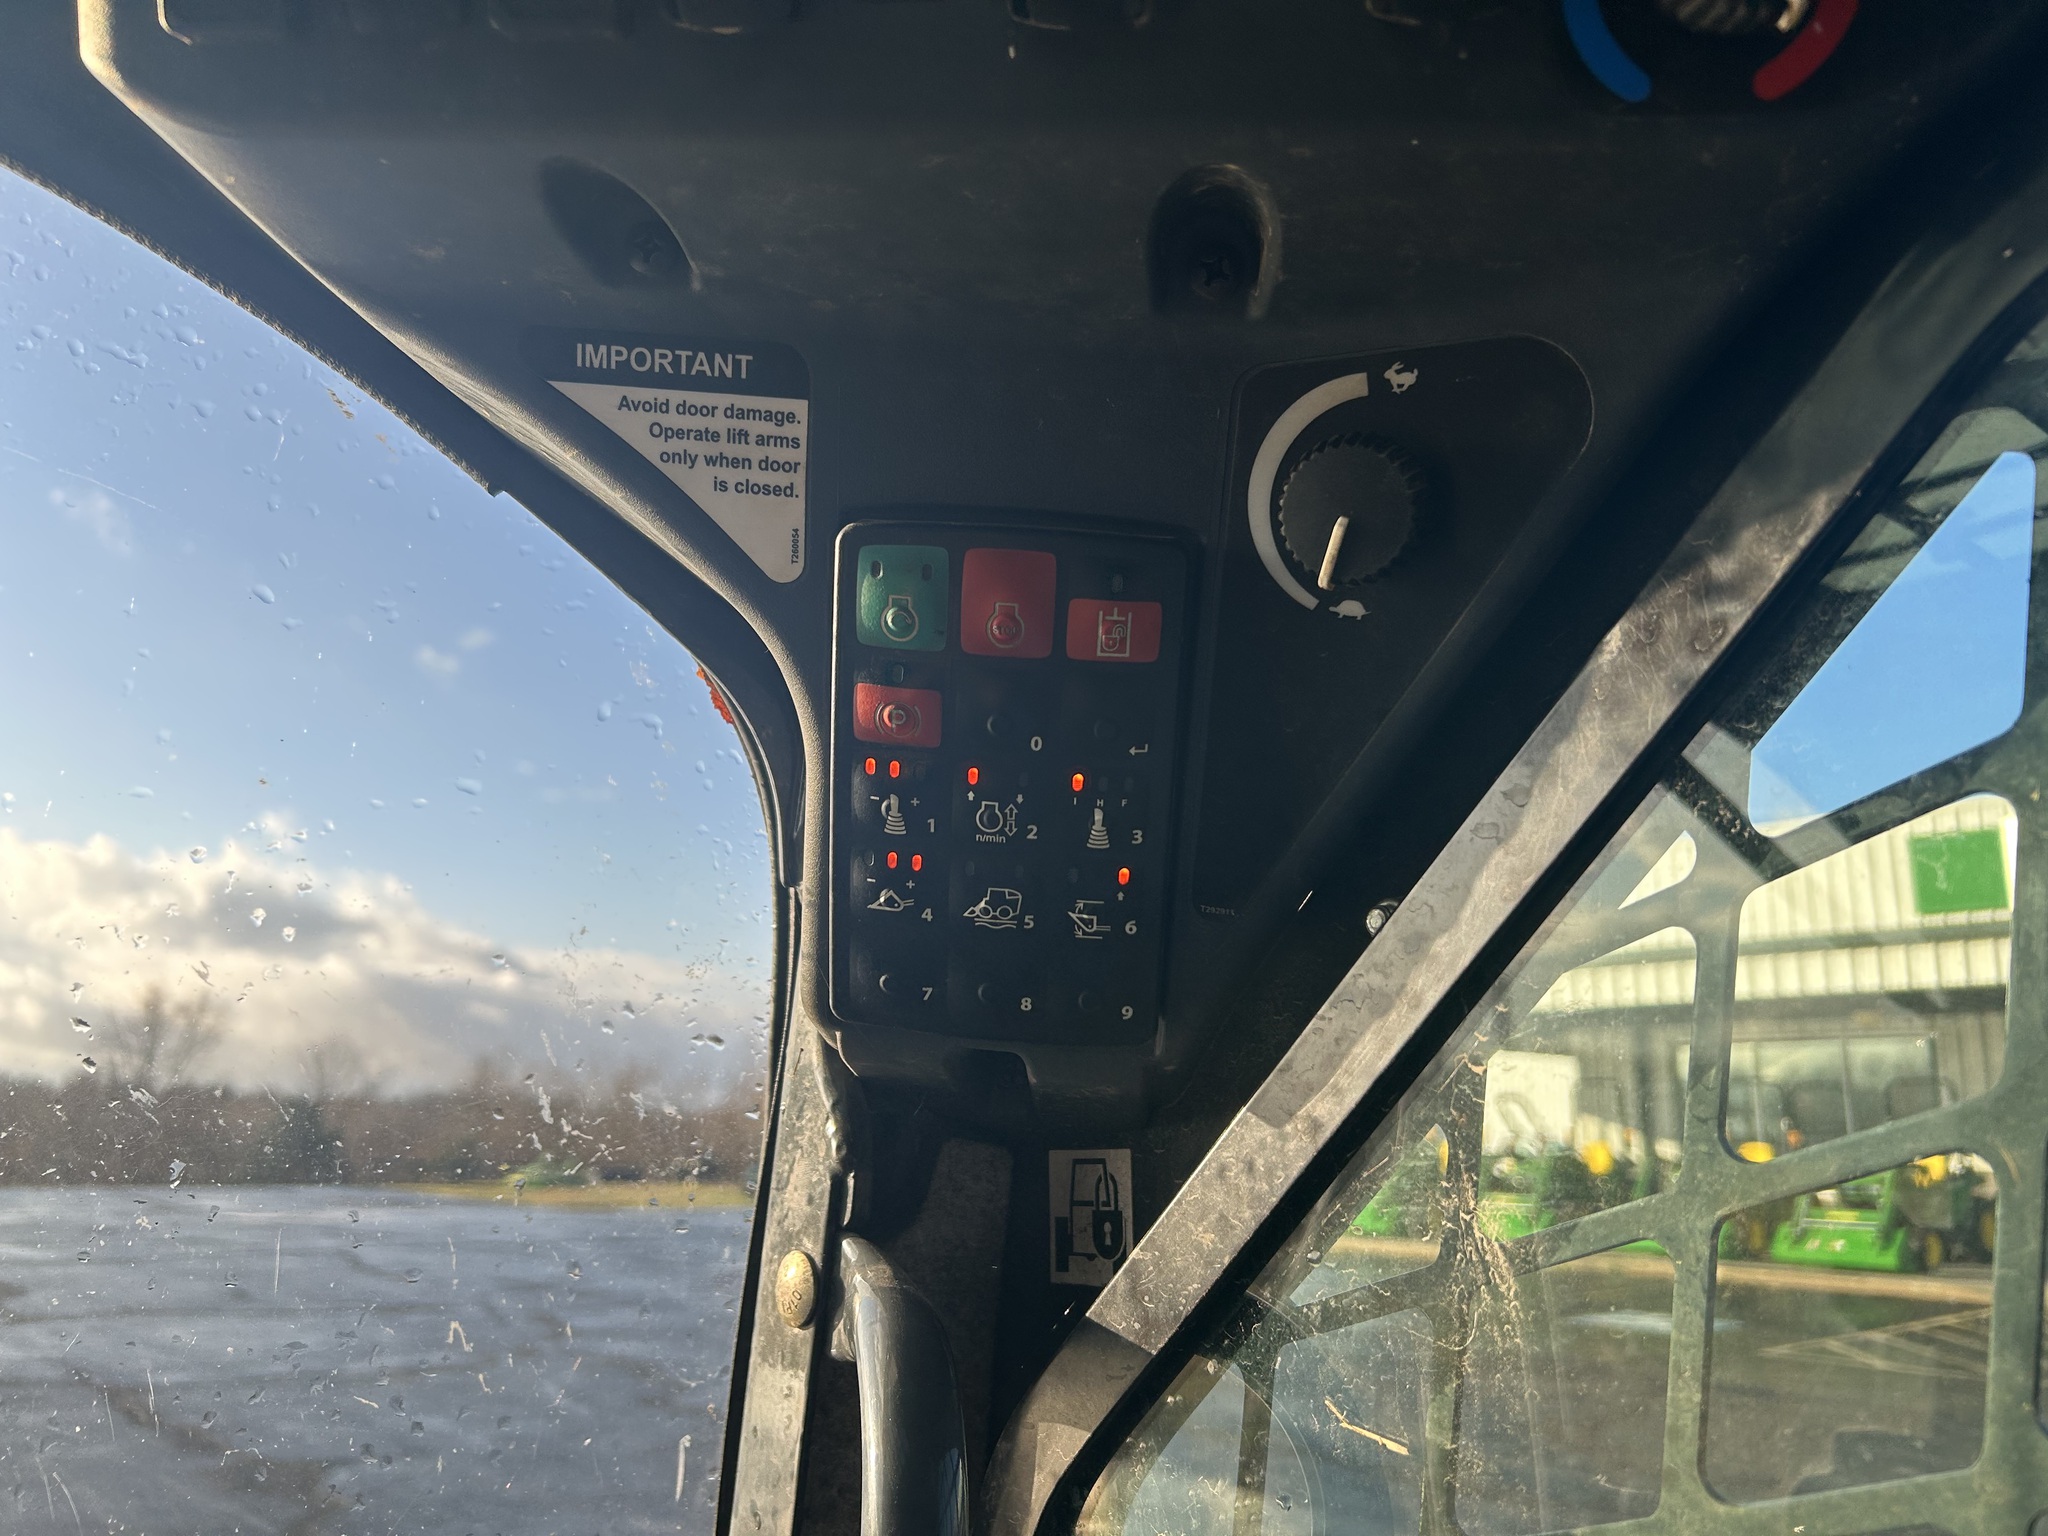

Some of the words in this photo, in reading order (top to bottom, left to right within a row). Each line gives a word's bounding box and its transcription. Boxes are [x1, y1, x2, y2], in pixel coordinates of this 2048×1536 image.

[575, 342, 754, 379] IMPORTANT
[617, 395, 670, 415] Avoid
[675, 399, 719, 418] door
[723, 404, 802, 427] damage.
[648, 422, 721, 443] Operate
[726, 428, 750, 446] lift
[755, 434, 801, 450] arms
[659, 449, 699, 470] only
[703, 452, 752, 471] when
[758, 457, 801, 474] door
[713, 476, 729, 493] is
[734, 479, 800, 499] closed.
[790, 527, 800, 566] T260054
[1096, 798, 1104, 807] H
[1121, 798, 1128, 807] F
[926, 818, 936, 833] 1
[1026, 825, 1038, 840] 2
[975, 833, 1006, 843] n/min
[1131, 829, 1143, 845] 3
[921, 907, 933, 922] 4
[1023, 914, 1034, 929] 5
[1125, 920, 1137, 935] 6
[922, 987, 933, 1002] 7
[1020, 997, 1032, 1012] 8
[1121, 1005, 1133, 1020] 9
